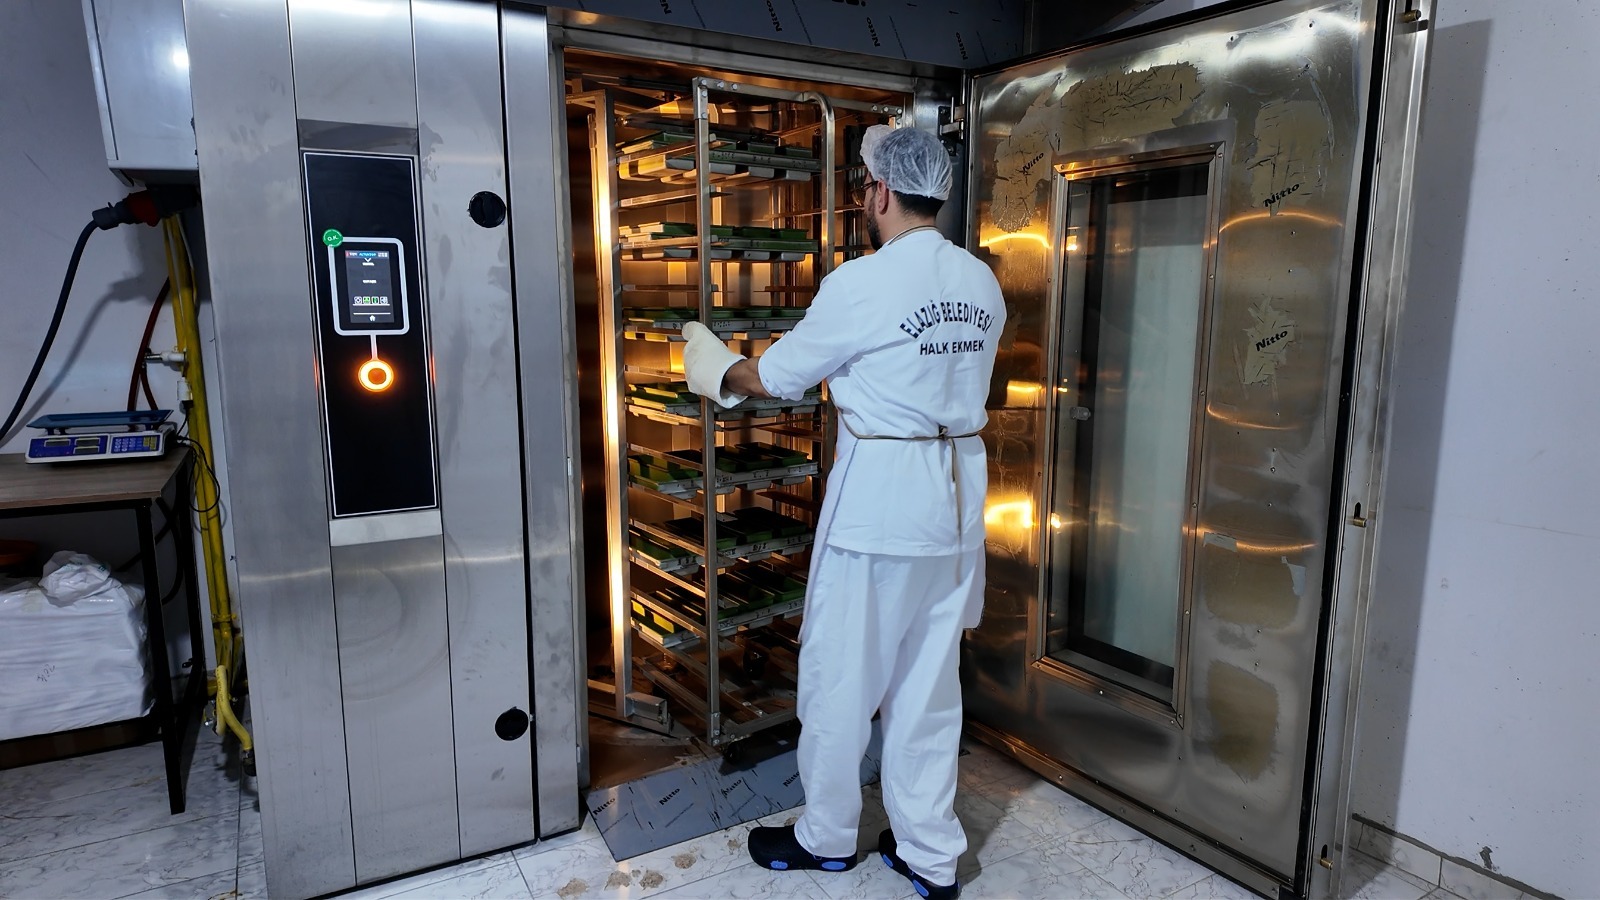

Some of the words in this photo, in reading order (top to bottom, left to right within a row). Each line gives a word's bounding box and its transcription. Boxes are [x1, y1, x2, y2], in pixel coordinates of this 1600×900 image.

[866, 16, 881, 47] Nitto
[955, 31, 969, 61] Nitto
[1022, 152, 1044, 172] Nitto
[1263, 183, 1300, 208] Nitto
[899, 299, 941, 339] ELAZIĞ
[940, 301, 995, 334] BELEDİYESİ
[919, 341, 949, 356] HALK
[951, 339, 985, 354] EKMEK
[1255, 330, 1288, 352] Nitto
[592, 797, 616, 816] Nitto
[658, 787, 681, 806] Nitto
